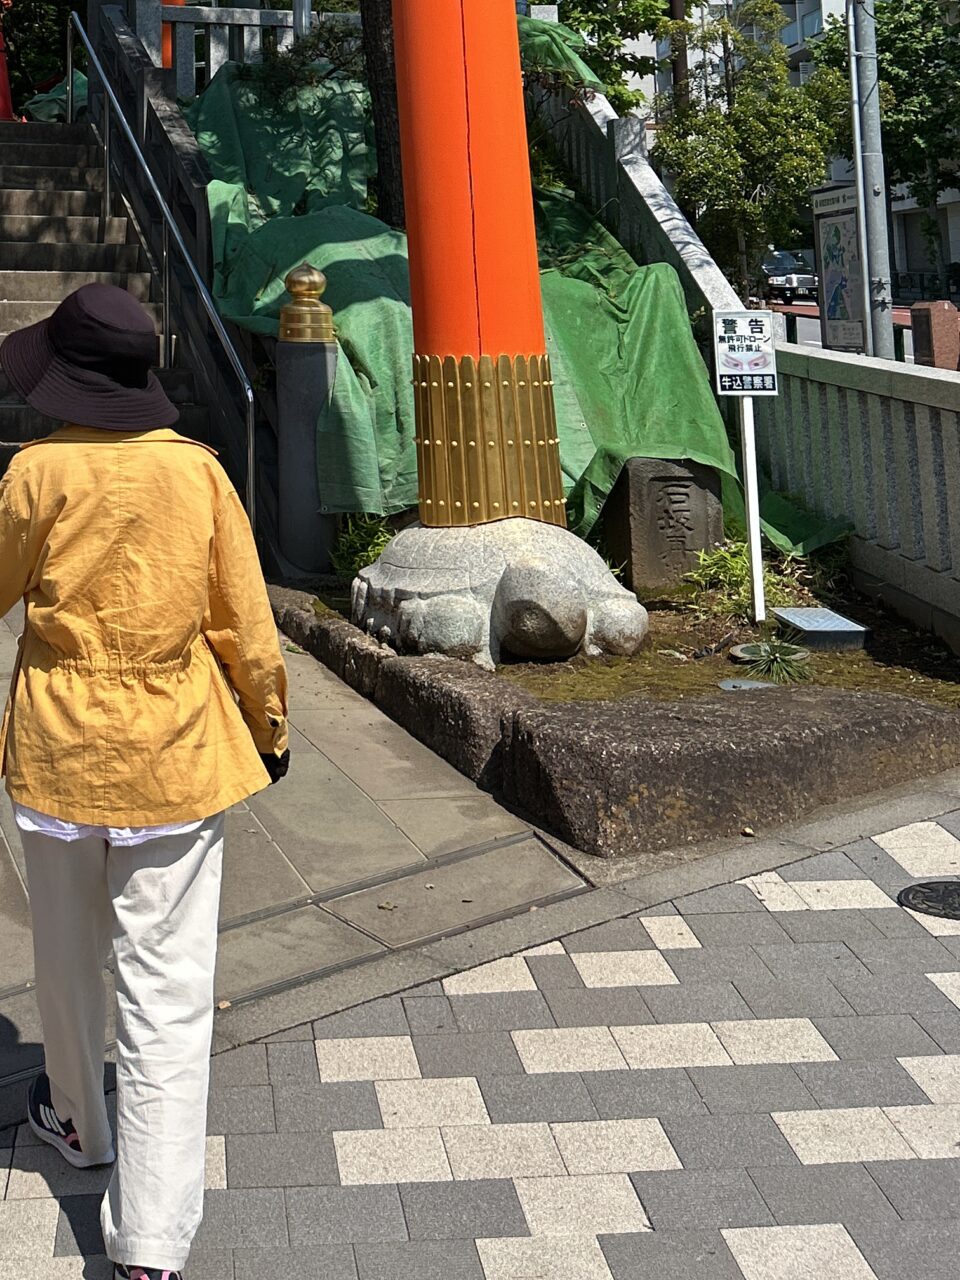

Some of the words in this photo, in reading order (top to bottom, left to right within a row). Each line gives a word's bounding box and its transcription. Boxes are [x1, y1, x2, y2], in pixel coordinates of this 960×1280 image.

[722, 318, 764, 334] 警告
[718, 335, 771, 343] 無許可ドローン
[728, 344, 762, 352] 飛行禁止
[721, 376, 773, 389] 牛込警察署
